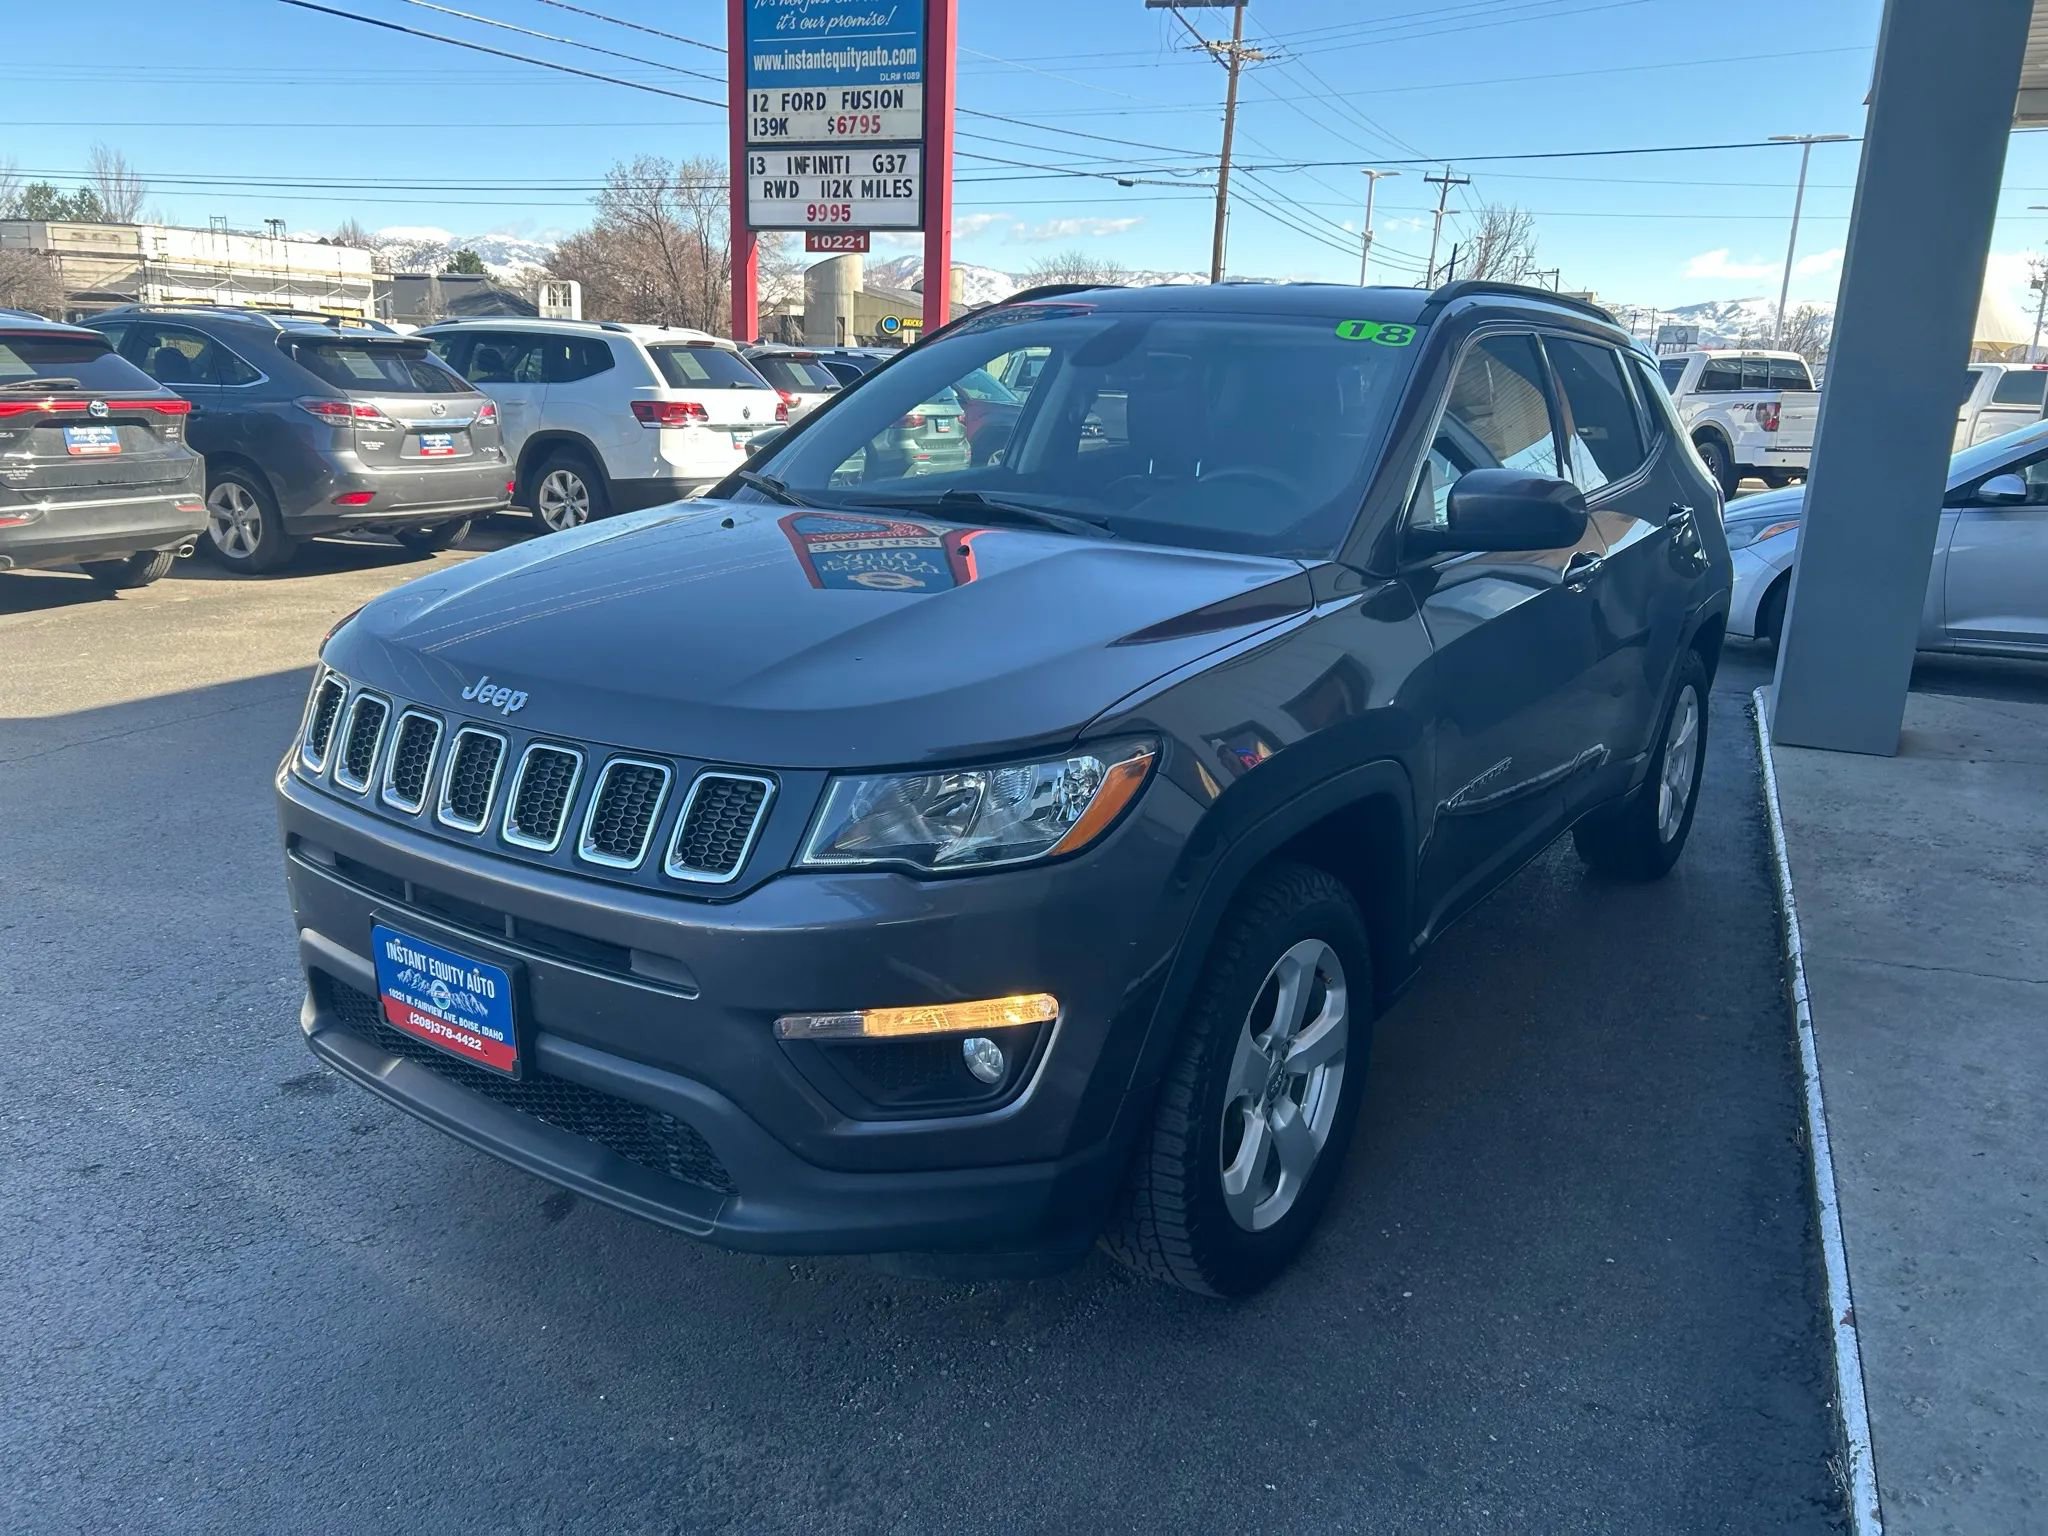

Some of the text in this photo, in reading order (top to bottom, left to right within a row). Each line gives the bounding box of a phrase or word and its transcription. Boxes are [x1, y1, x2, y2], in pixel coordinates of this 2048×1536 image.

[776, 5, 898, 35] it's our promise!
[753, 46, 917, 73] www.instantequityauto.com
[880, 72, 920, 81] DLR# 1089
[753, 89, 904, 112] 12 FORD FUSION
[753, 115, 881, 136] 139K $6795
[750, 154, 907, 175] 13 INFINITI G37
[763, 178, 913, 199] RWD 112K MILES
[807, 204, 851, 222] 9995
[811, 235, 865, 249] 10221
[1348, 322, 1411, 343] 18
[1732, 402, 1755, 411] FX4
[462, 676, 528, 716] Jeep
[386, 941, 495, 998] INSTANT EQUITY AUTO
[388, 988, 504, 1041] 10221 W. FAIRVIEW AVE. BOISE, IDAHO
[409, 1011, 482, 1050] (208)378-4422
